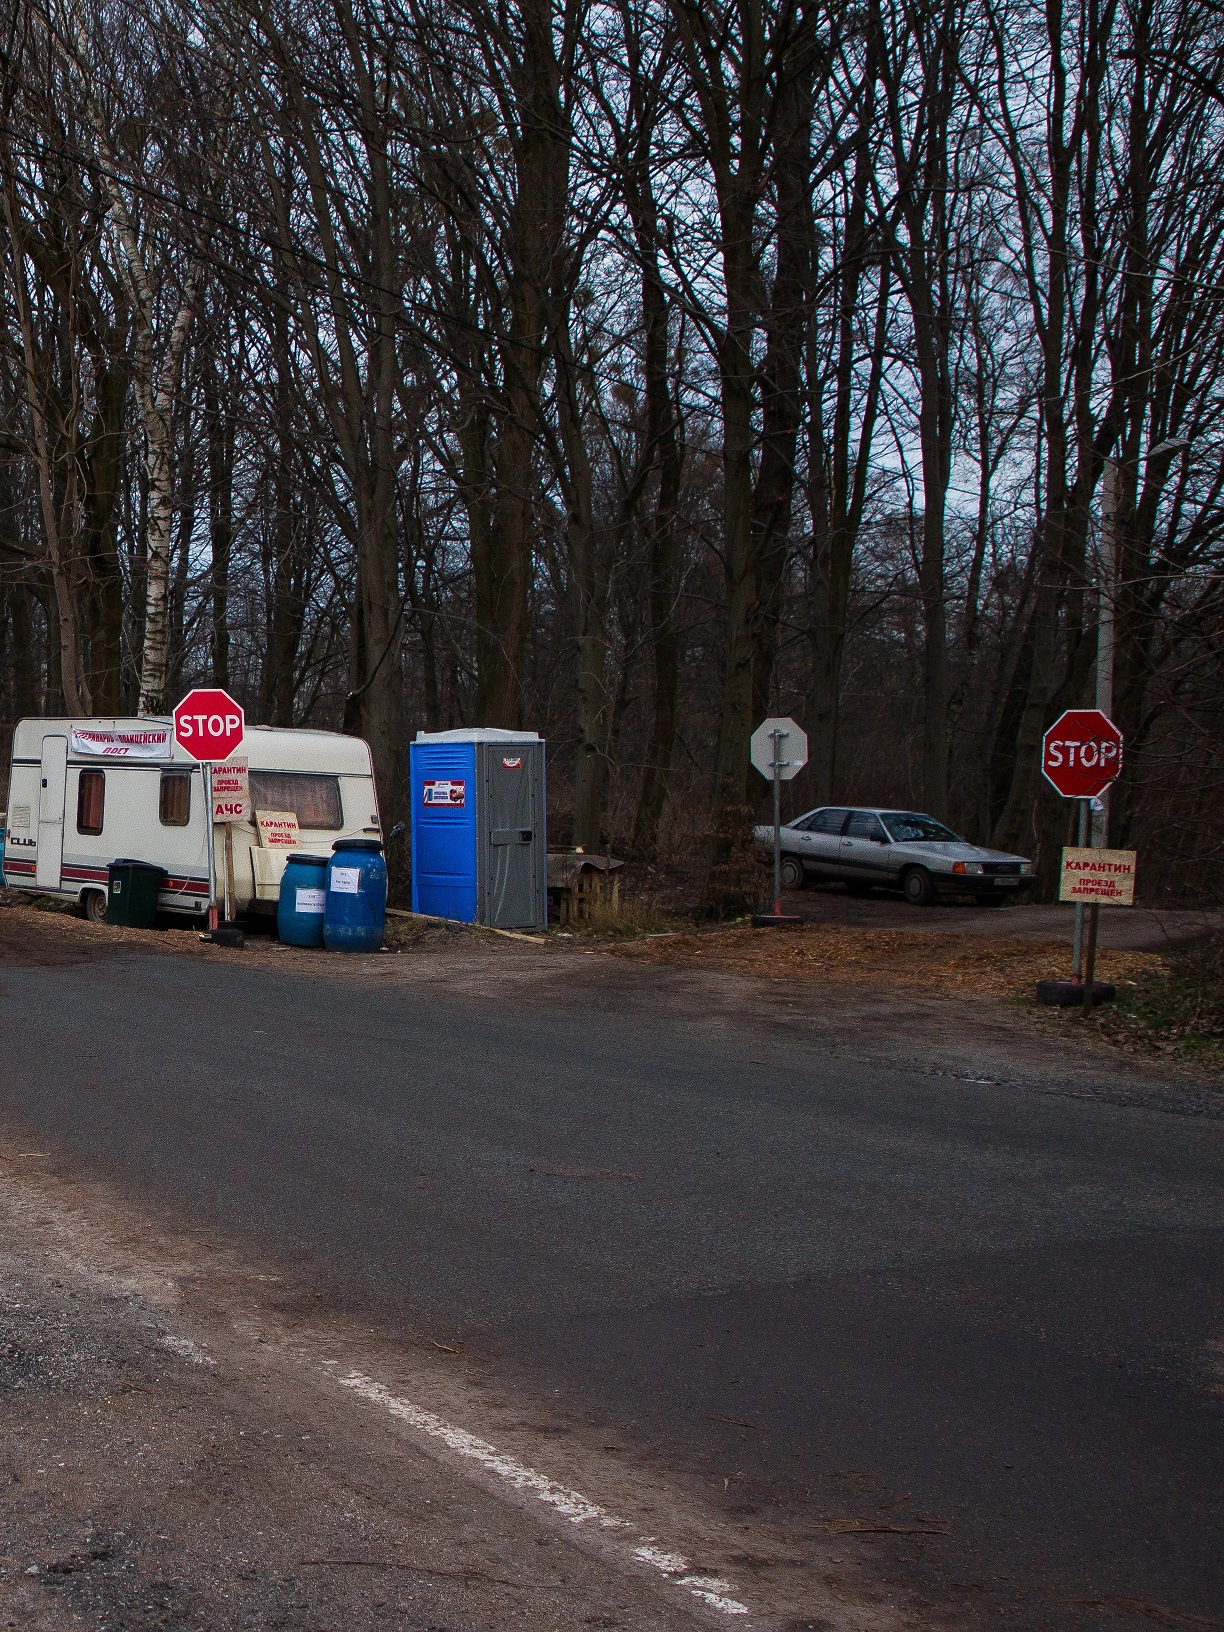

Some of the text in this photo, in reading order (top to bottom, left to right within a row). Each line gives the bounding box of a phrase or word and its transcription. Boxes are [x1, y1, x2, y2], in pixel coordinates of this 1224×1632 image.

[179, 714, 240, 737] STOP
[102, 746, 130, 755] ПОСТ
[1048, 740, 1117, 767] STOP
[211, 766, 246, 775] АРАНТИН
[215, 803, 243, 815] АЧС
[260, 820, 297, 829] КАРАНТИН
[267, 837, 297, 845] ЗАПРЕЩЕН
[1065, 860, 1131, 873] КАРАНТИН
[1079, 878, 1116, 888] ПРОЕЗД
[1071, 886, 1122, 897] ЗАПРЕЩЕН
